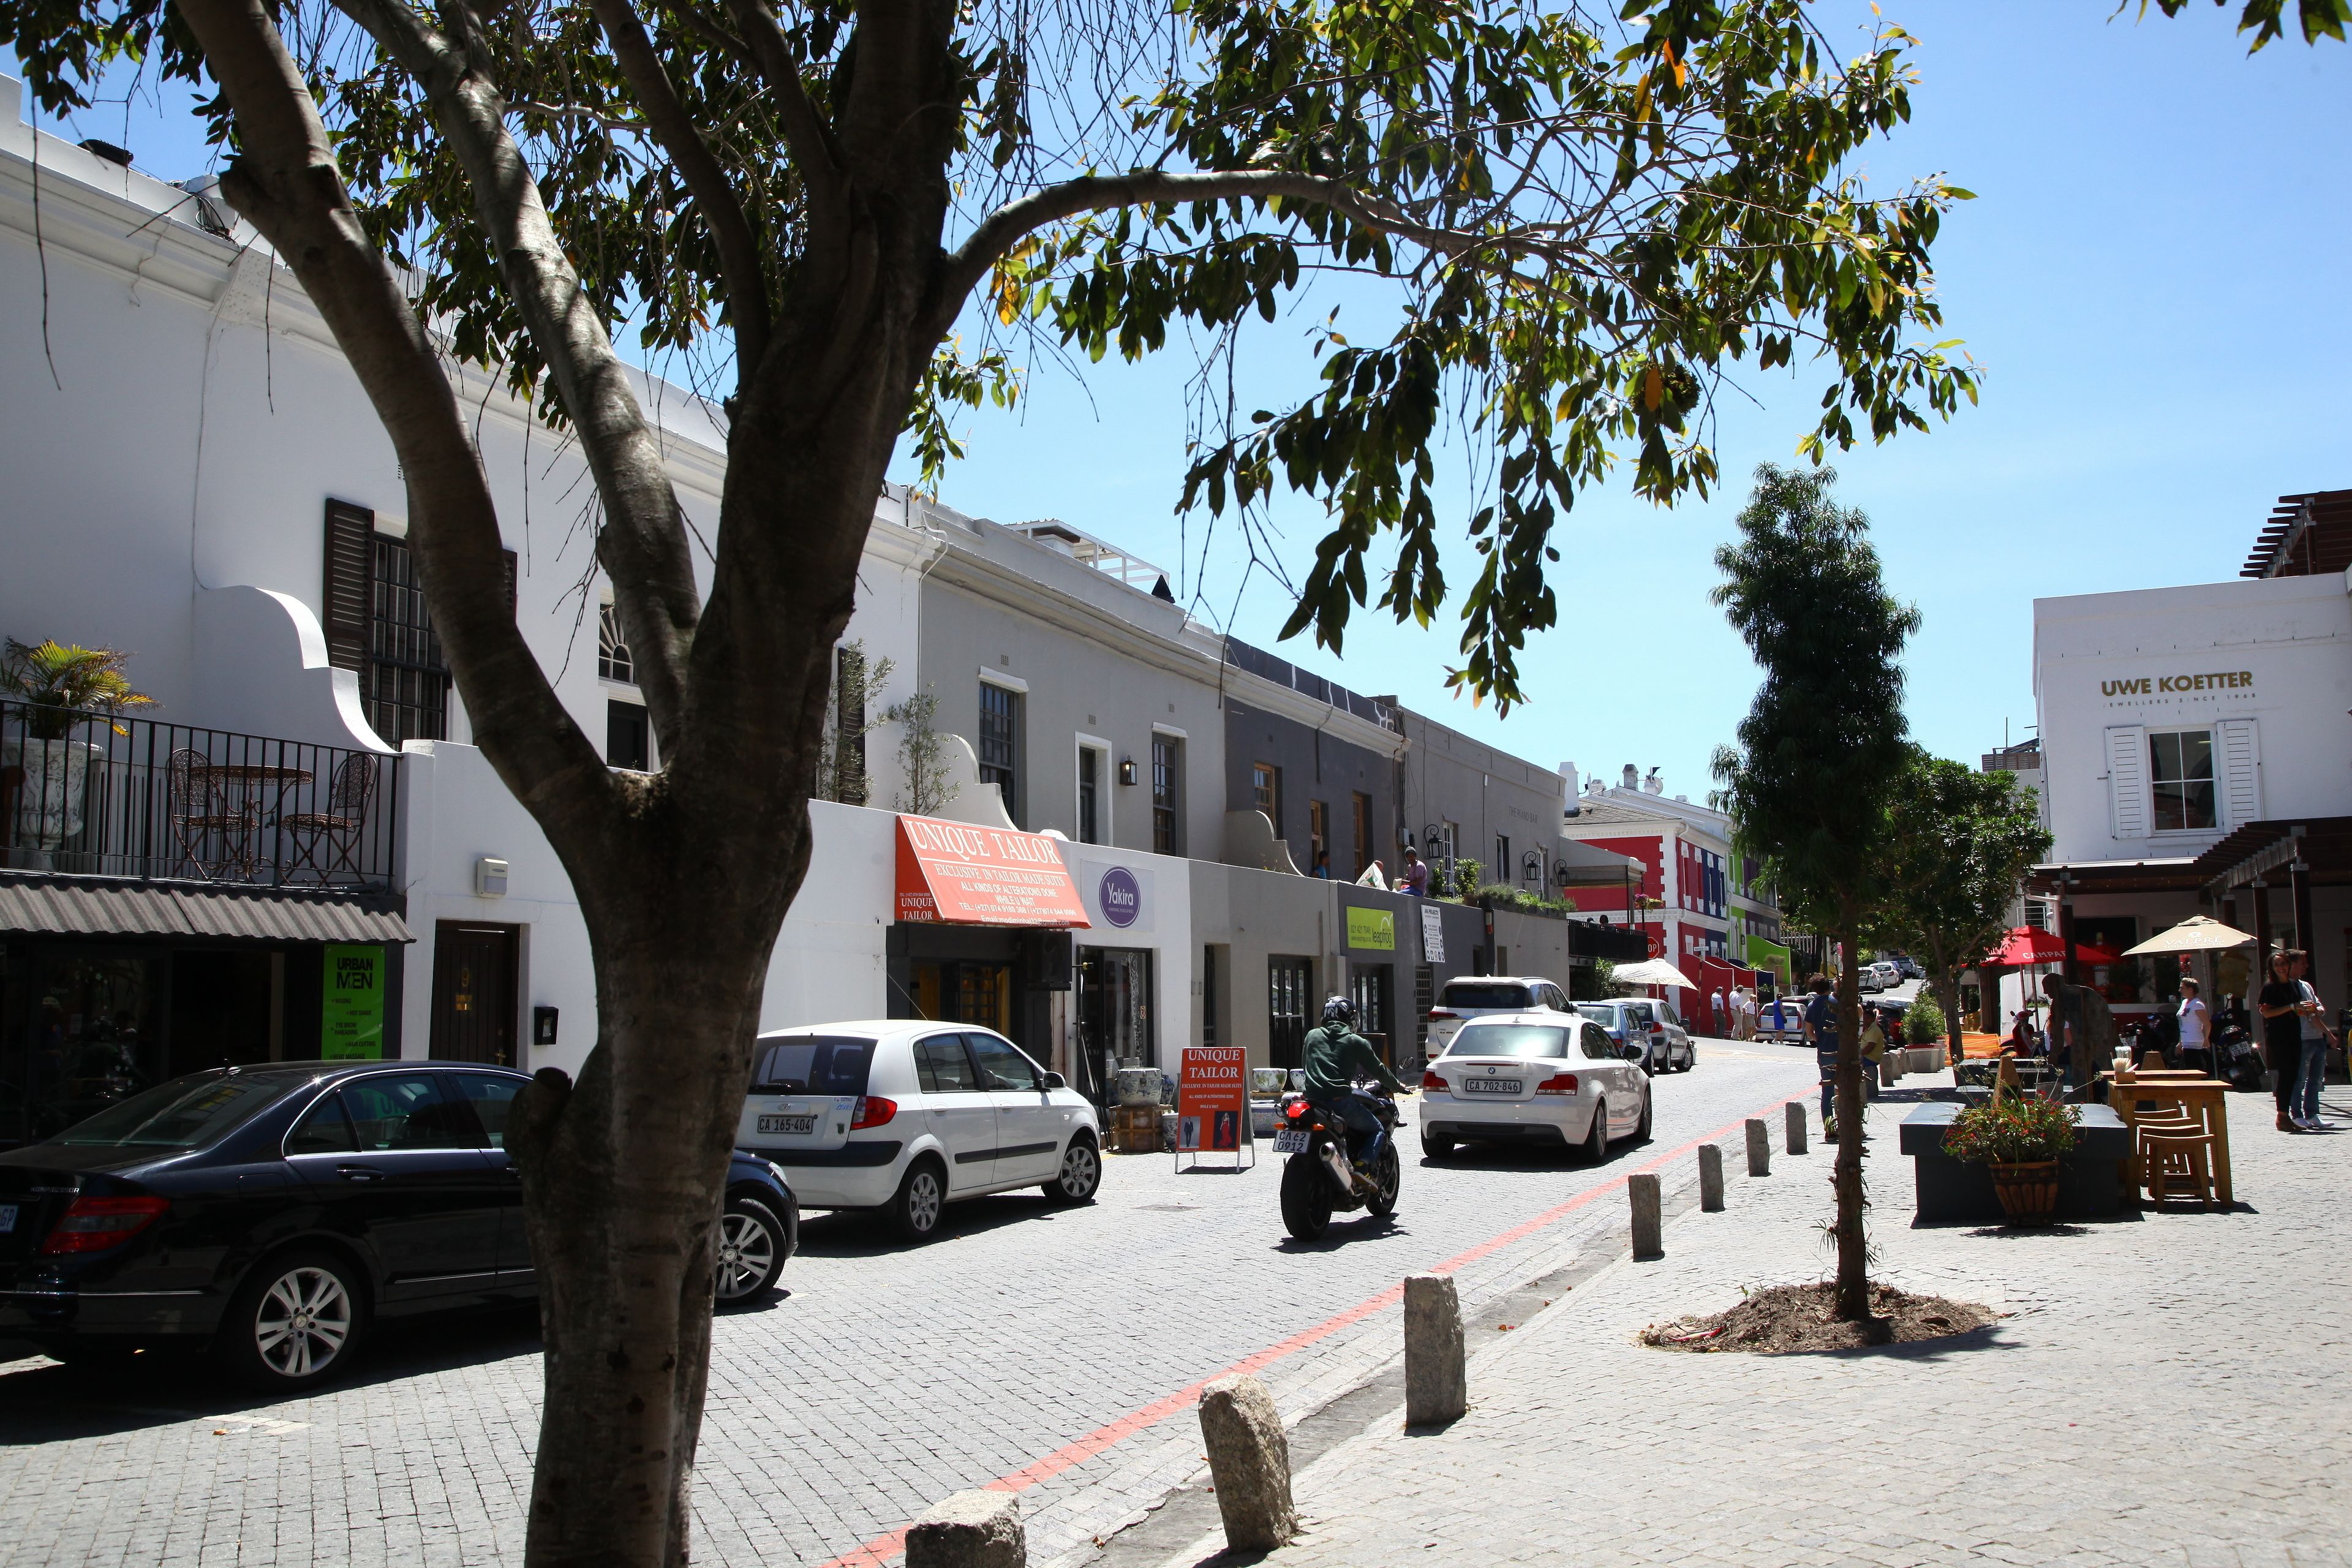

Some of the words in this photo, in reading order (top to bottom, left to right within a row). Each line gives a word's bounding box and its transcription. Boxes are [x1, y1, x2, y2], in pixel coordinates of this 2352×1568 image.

[2101, 678, 2152, 696] UWE
[2159, 671, 2253, 692] KOETTER
[905, 820, 991, 861] UNIQUE
[990, 832, 1063, 864] TAILOR
[933, 863, 982, 880] EXCLUSIVE
[981, 869, 993, 880] IN
[992, 870, 1023, 883] TAILOR
[1020, 872, 1046, 885] MADE
[1044, 875, 1066, 887] SUITS
[960, 881, 974, 891] ALL
[973, 882, 993, 892] KINDS
[993, 884, 1001, 893] OF
[1002, 884, 1042, 896] ALTERATIONS
[1041, 888, 1058, 897] DONE
[1107, 882, 1134, 906] Yakira
[902, 897, 933, 908] UNIQUE
[994, 894, 1015, 904] WHILE
[1014, 896, 1020, 905] U
[1019, 897, 1035, 906] WAIT
[959, 902, 974, 911] TEL:
[903, 911, 933, 920] TAILOR
[1372, 927, 1392, 948] leapfrog
[1648, 944, 1657, 952] OP
[2022, 951, 2067, 959] CAMPA
[337, 957, 373, 971] URBAN
[336, 971, 373, 989] MEN
[1188, 1050, 1240, 1063] UNIQUE
[1189, 1067, 1238, 1078] TAILOR
[1469, 1081, 1479, 1090] CA
[759, 1118, 770, 1130] CA
[1280, 1131, 1291, 1140] CA
[1294, 1133, 1306, 1142] 62
[1278, 1141, 1304, 1152] 0912
